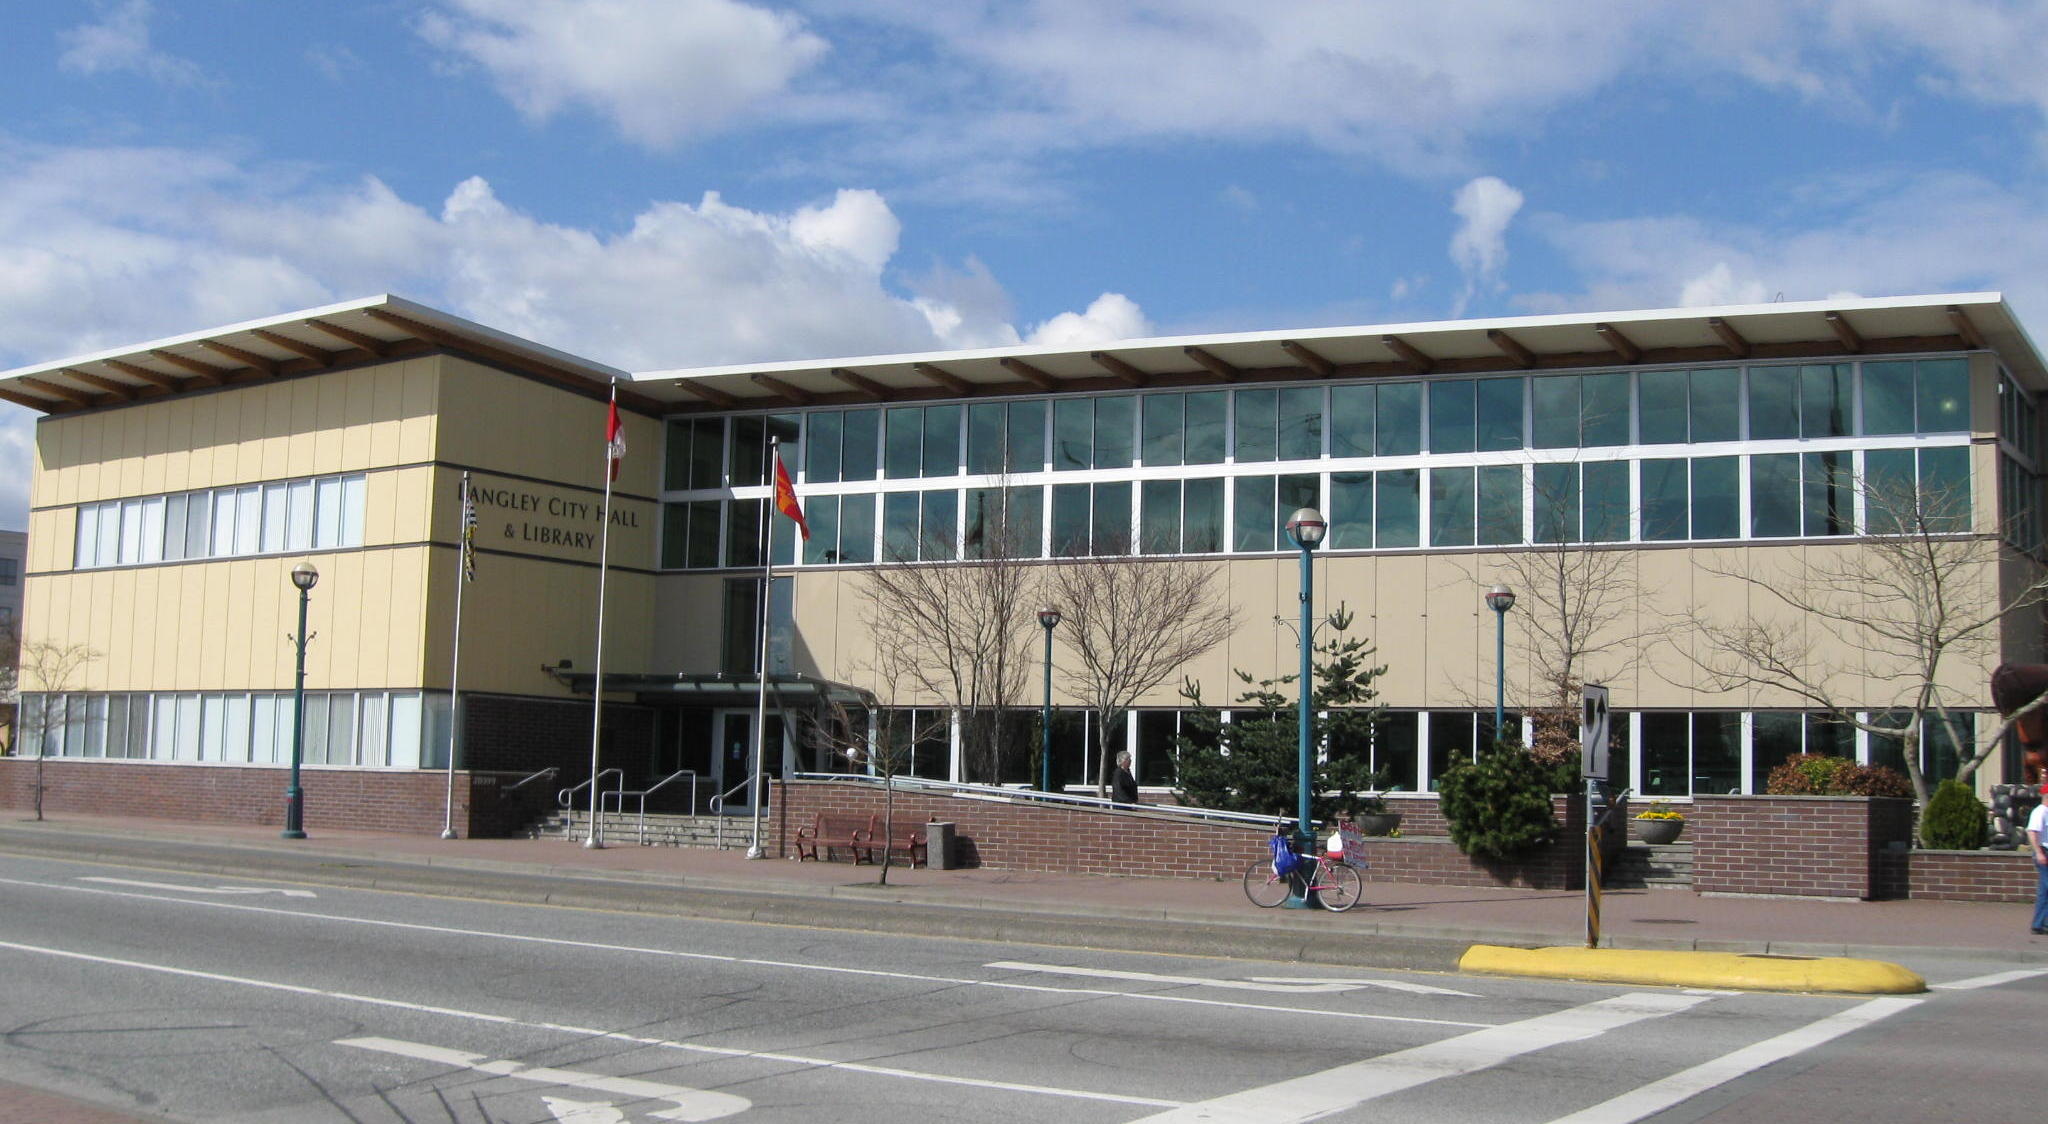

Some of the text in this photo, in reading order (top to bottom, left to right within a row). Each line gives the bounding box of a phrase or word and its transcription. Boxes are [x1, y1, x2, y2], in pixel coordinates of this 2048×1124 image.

[458, 481, 639, 528] LANGLEY CITY HALL
[504, 522, 596, 550] & LIBRARY
